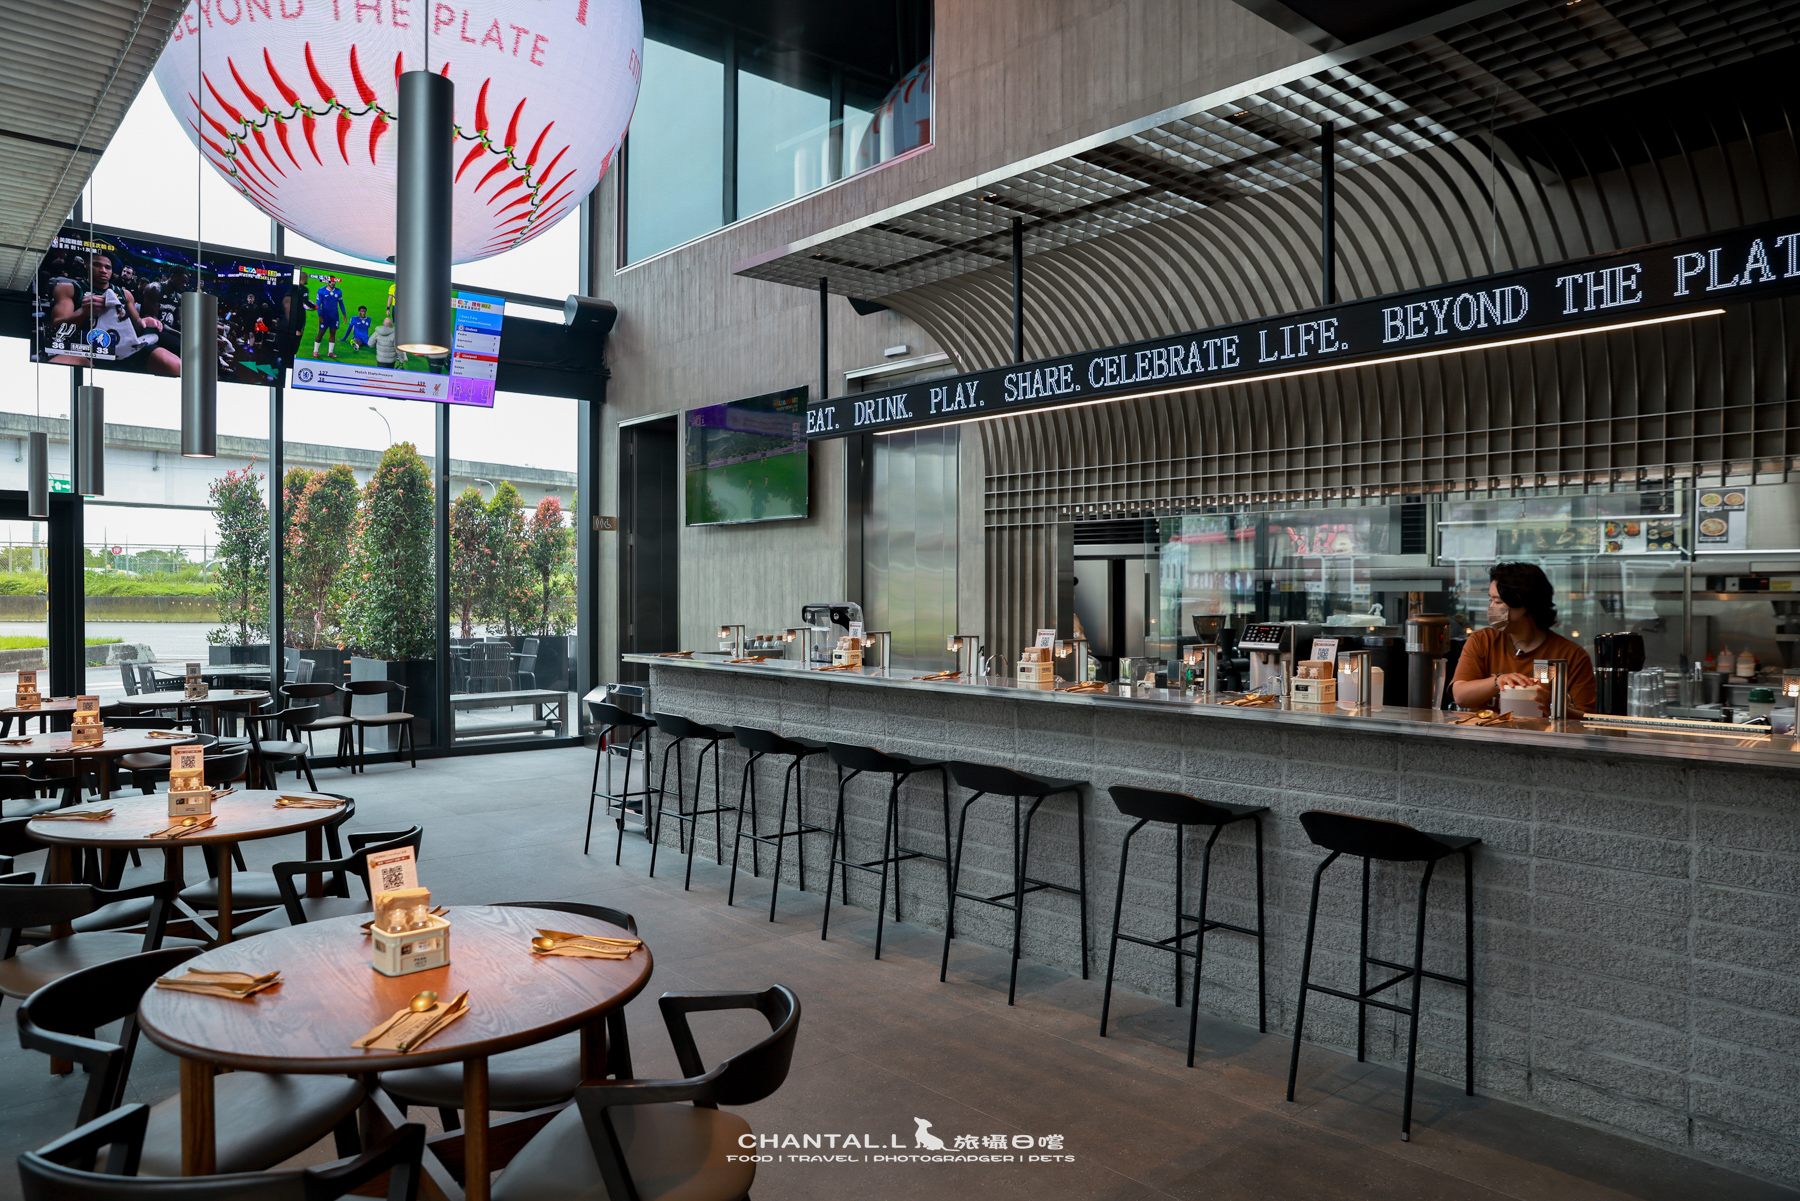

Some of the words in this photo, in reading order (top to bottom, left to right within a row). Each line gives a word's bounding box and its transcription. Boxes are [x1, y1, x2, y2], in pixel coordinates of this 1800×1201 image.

[173, 0, 304, 41] EYOND
[433, 3, 549, 67] PLATE
[51, 341, 65, 350] 36
[96, 346, 109, 354] 33
[806, 407, 839, 433] EAT.
[854, 393, 913, 426] DRINK.
[929, 381, 984, 413] PLAY.
[1004, 364, 1081, 402] SHARE.
[1088, 335, 1239, 388] CELEBRATE
[1258, 317, 1349, 363] LIFE.
[1382, 285, 1529, 344] BEYOND
[1556, 263, 1643, 315] THE
